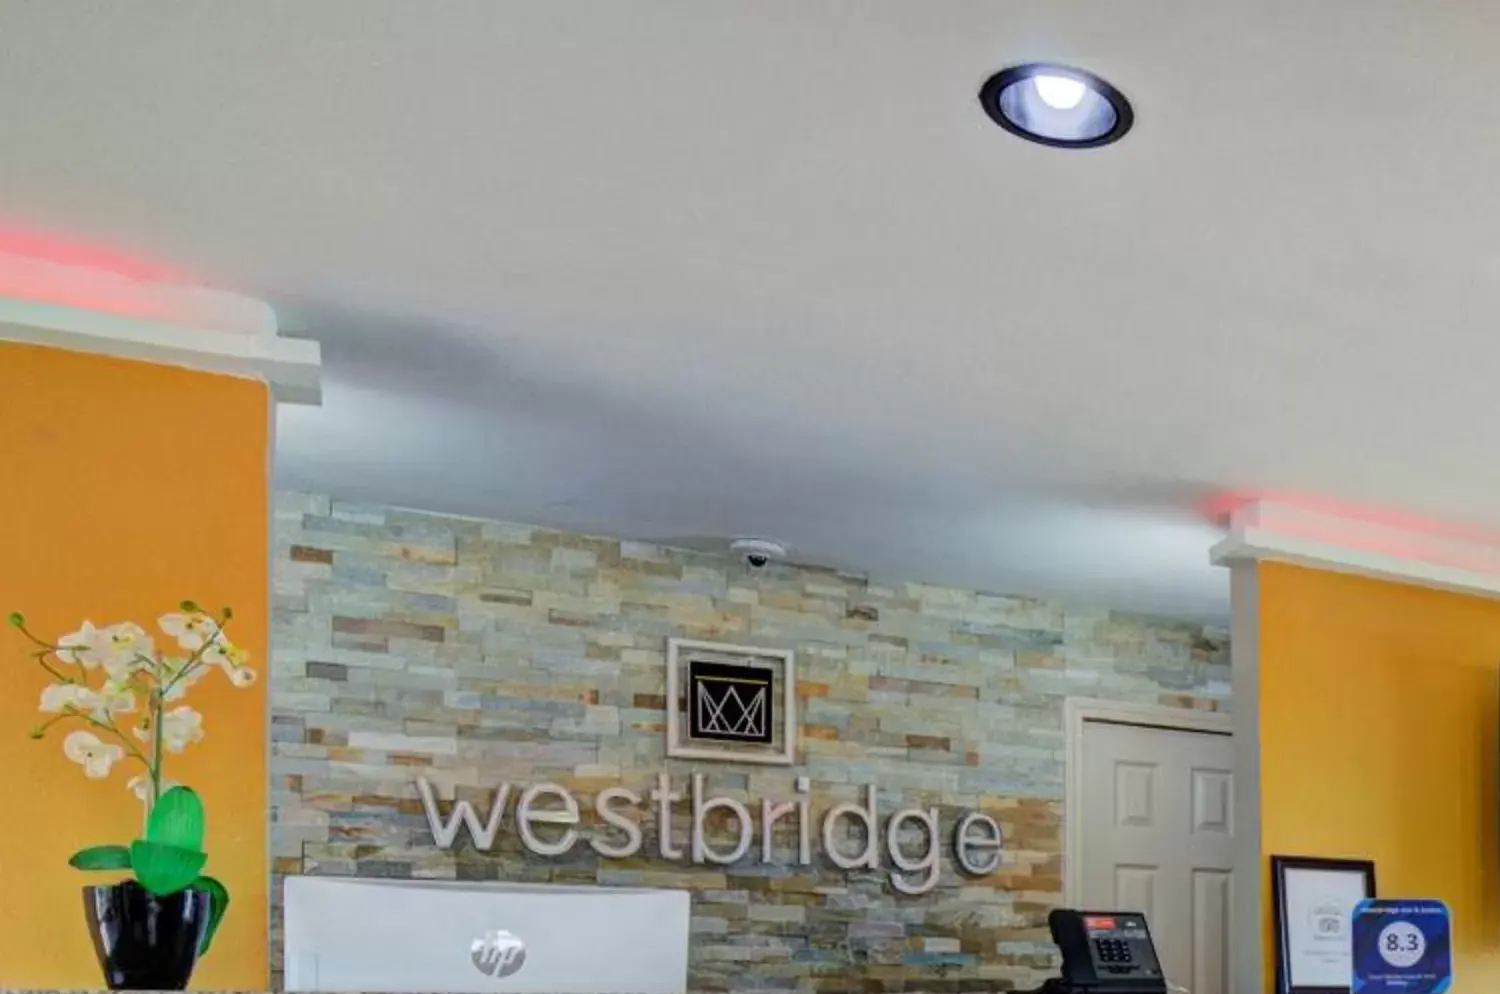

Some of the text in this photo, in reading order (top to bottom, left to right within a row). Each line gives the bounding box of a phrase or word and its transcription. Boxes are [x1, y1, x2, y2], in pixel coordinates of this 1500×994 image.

[415, 772, 1003, 895] westbridge
[476, 933, 522, 979] hp
[1386, 933, 1418, 951] 8.3
